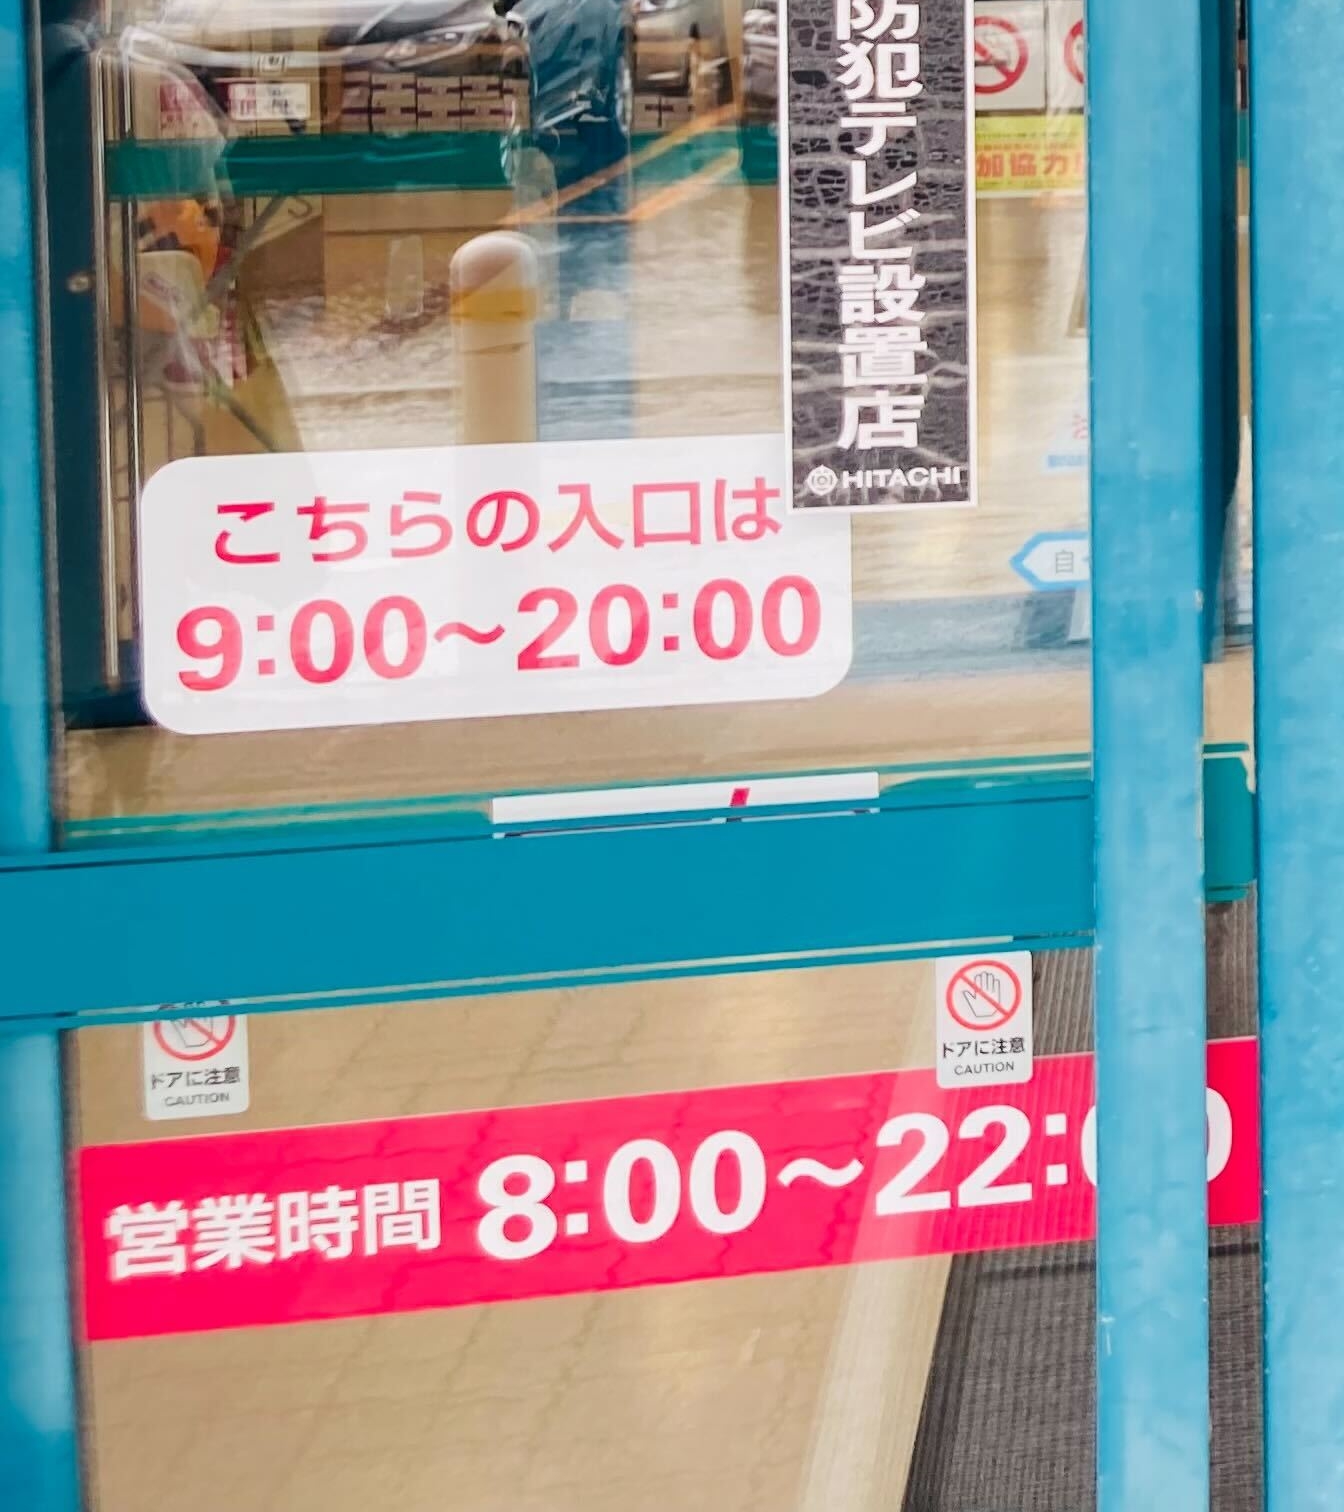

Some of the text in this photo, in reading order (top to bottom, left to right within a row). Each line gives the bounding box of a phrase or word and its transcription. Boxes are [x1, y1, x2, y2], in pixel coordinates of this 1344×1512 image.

[841, 465, 962, 489] HITACHI
[213, 477, 782, 565] こちらの入口は
[942, 1037, 1024, 1059] ドアに注意
[151, 1066, 241, 1090] ドアに注意
[954, 1061, 1015, 1076] CAUTION
[164, 1092, 230, 1107] CAUTION
[107, 1178, 442, 1281] 営業時間
